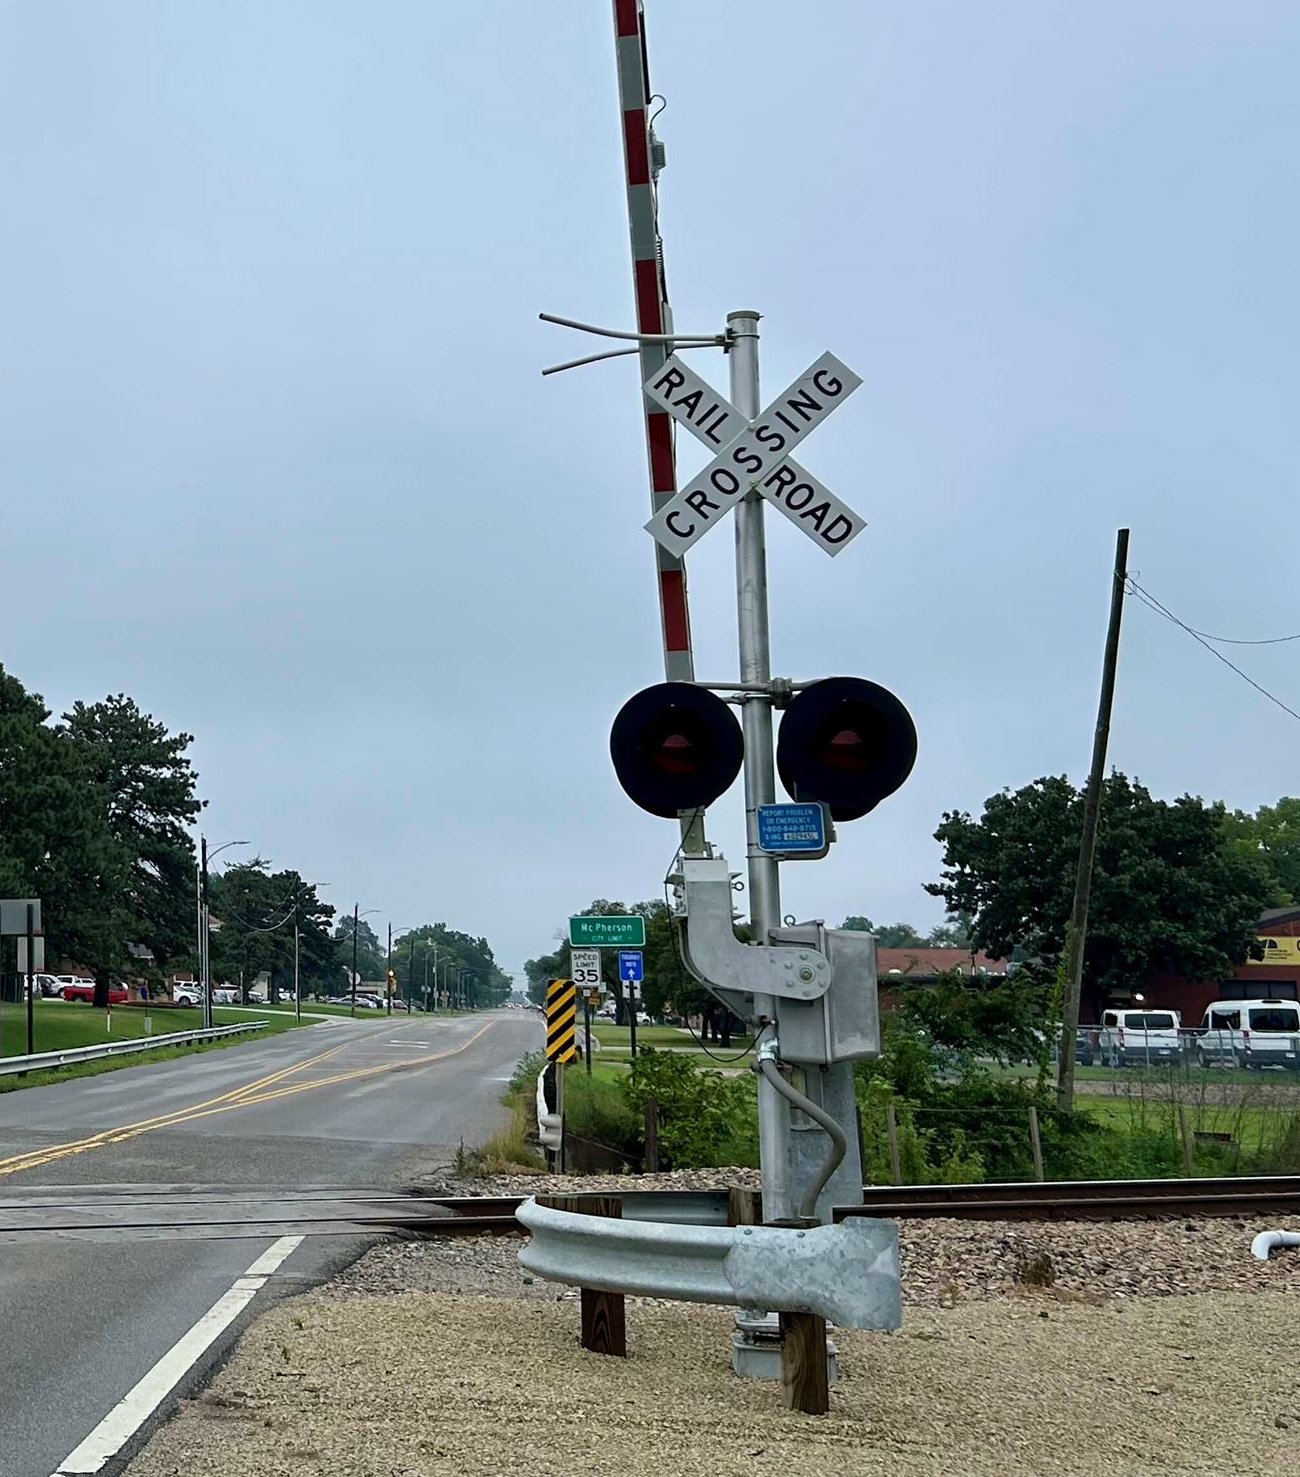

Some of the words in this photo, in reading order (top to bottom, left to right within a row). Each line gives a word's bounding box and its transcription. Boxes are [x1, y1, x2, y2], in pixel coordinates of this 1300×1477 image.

[653, 367, 729, 444] RAIL
[665, 369, 843, 538] CROSSING
[763, 464, 853, 544] ROAD
[595, 923, 632, 932] Pherson
[574, 969, 598, 982] 35
